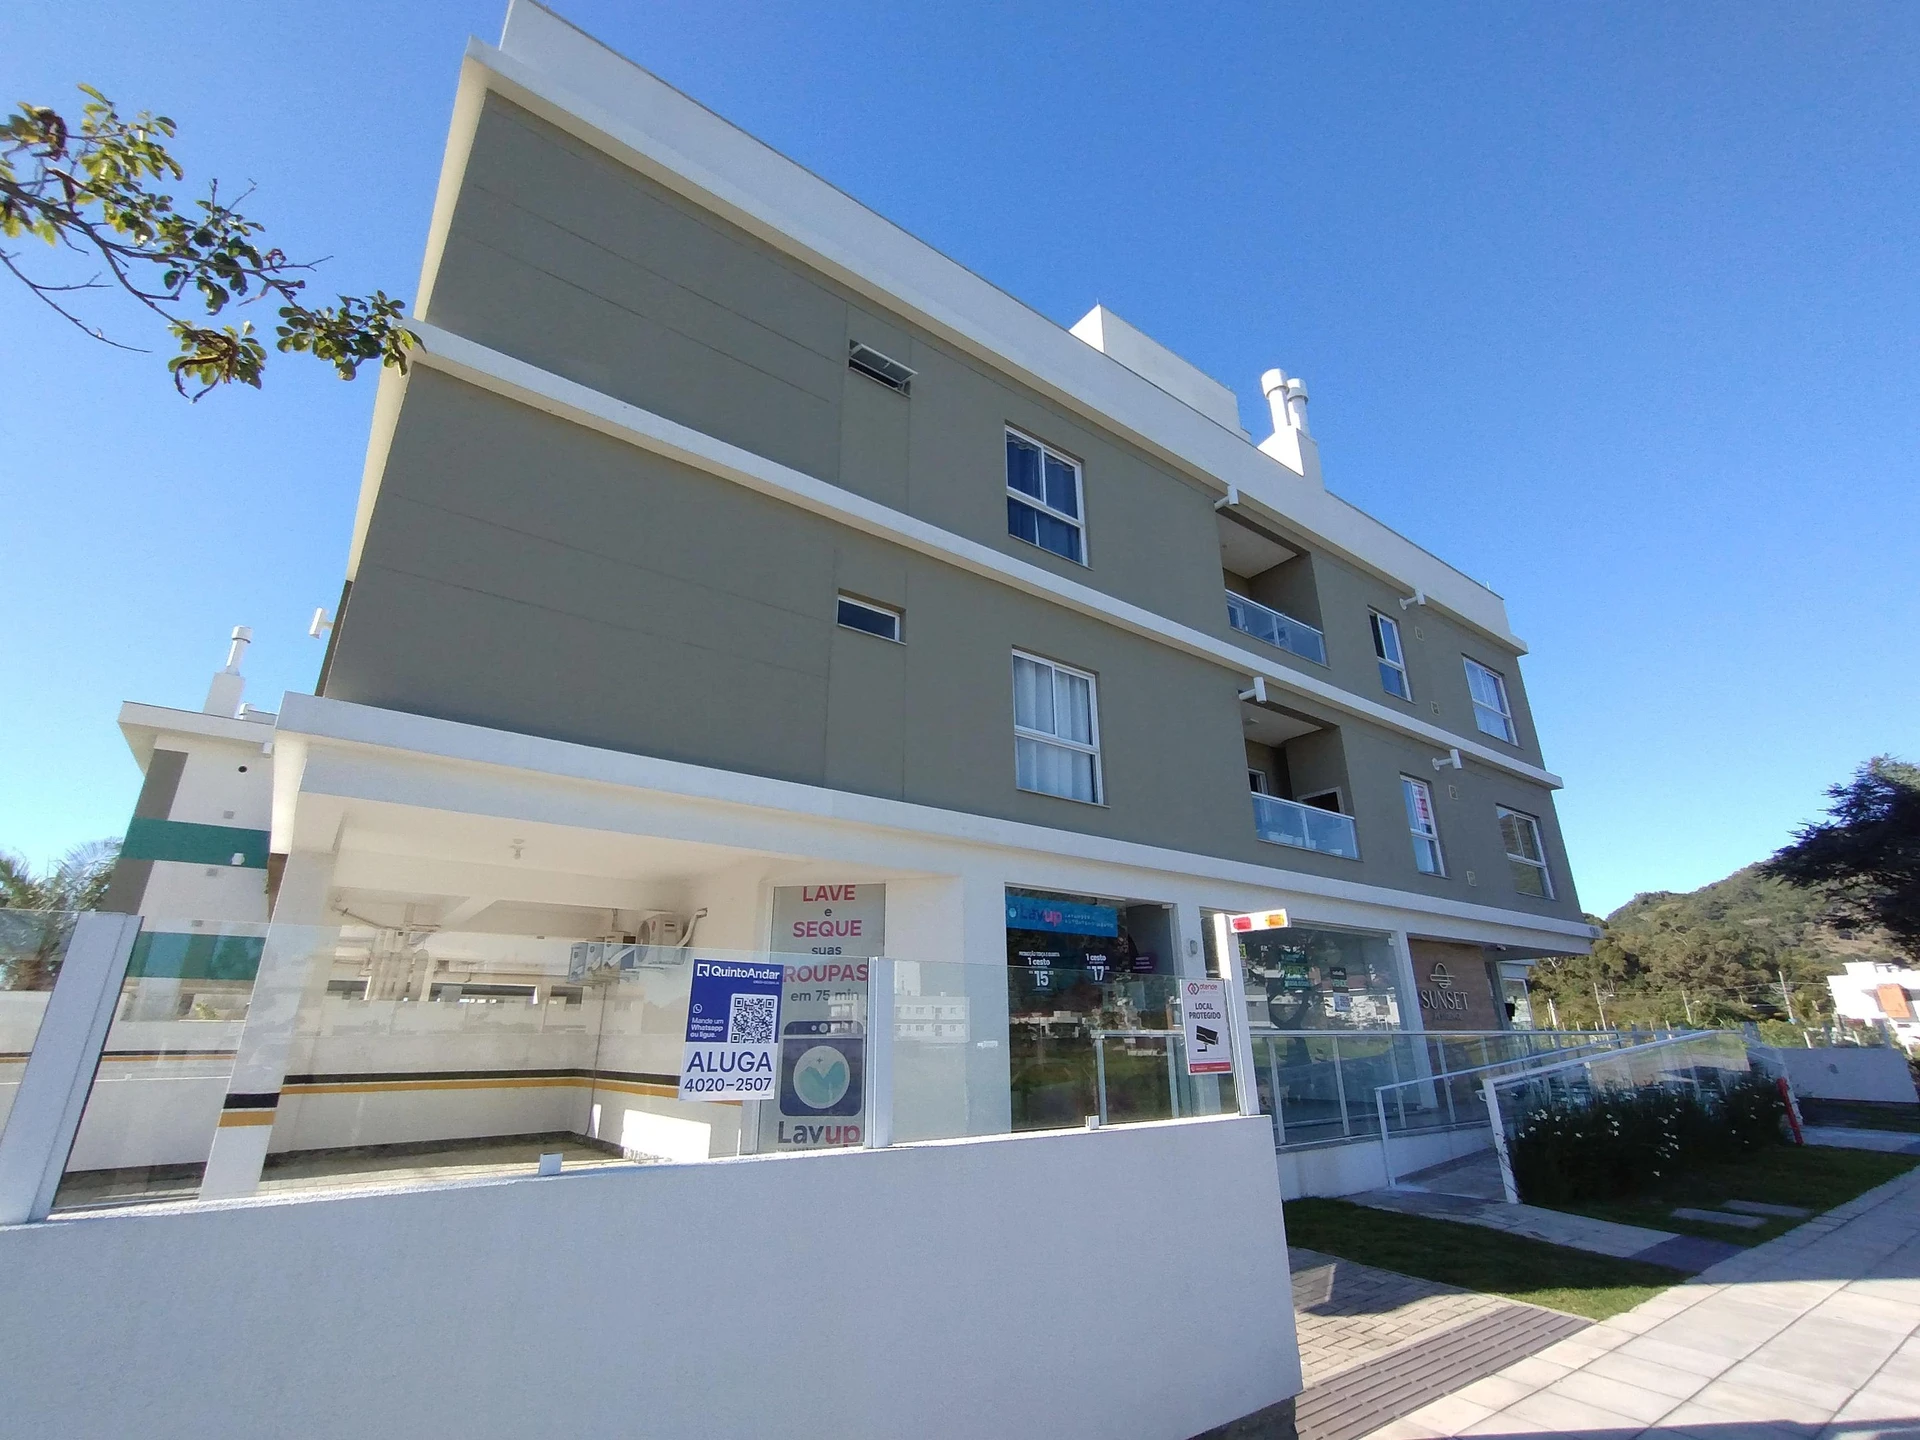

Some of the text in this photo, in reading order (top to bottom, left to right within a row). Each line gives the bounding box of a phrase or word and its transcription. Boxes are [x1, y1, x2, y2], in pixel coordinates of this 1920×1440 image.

[803, 884, 856, 902] LAVE
[824, 908, 833, 917] e
[1020, 904, 1063, 927] Lavup
[792, 920, 862, 938] SEQUE
[811, 946, 843, 956] suas
[1085, 953, 1107, 962] 1 cesto
[1027, 957, 1051, 966] 1 cesto
[711, 965, 780, 980] QuintoAndar
[783, 964, 869, 983] ROUPAS
[1034, 970, 1049, 987] 15
[1091, 965, 1105, 981] 17
[790, 992, 812, 1002] em
[815, 989, 831, 1002] 75
[1421, 990, 1469, 1010] SUNSET
[1195, 1002, 1214, 1011] LOCAL
[691, 1017, 714, 1025] Mande
[1188, 1011, 1222, 1020] PROTEGIDO
[691, 1024, 724, 1032] Whatsapp
[699, 1031, 717, 1039] ligue.
[686, 1051, 773, 1073] ALUGA
[684, 1077, 772, 1093] 4020-2507
[778, 1121, 861, 1147] Lavup
